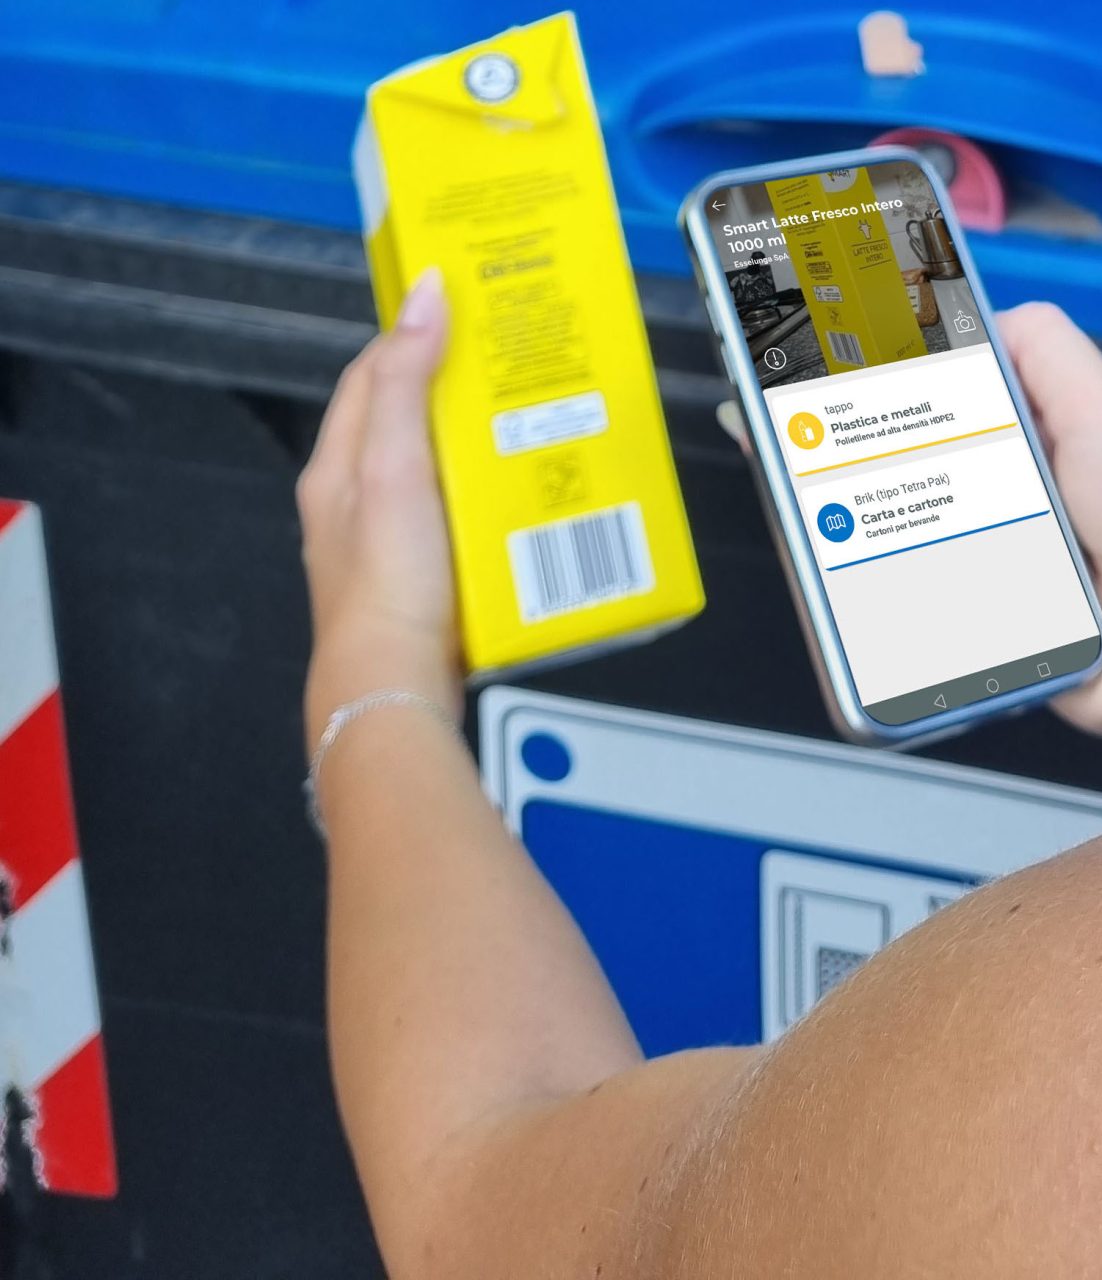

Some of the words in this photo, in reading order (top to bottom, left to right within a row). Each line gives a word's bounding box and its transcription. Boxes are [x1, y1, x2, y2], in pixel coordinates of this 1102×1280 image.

[723, 220, 769, 236] Smart
[772, 213, 808, 228] Latte
[812, 206, 858, 222] Fresco
[862, 199, 902, 213] Intero
[728, 237, 763, 253] 1000
[768, 233, 786, 246] ml
[853, 247, 868, 256] LATTE
[869, 243, 888, 252] FRESCO
[734, 256, 772, 268] Esselunga
[774, 254, 789, 262] SpA
[824, 401, 854, 416] tappo
[831, 414, 879, 434] Plastica
[881, 413, 889, 422] e
[891, 401, 932, 420] metalli
[835, 433, 875, 447] Polietilene
[876, 429, 886, 439] ad
[887, 426, 901, 435] alta
[902, 419, 929, 433] densità
[930, 413, 955, 426] HDPE2
[854, 491, 875, 506] Brik
[876, 485, 899, 502] (tipo
[900, 480, 926, 494] Tetra
[927, 473, 950, 488] Pak)
[861, 509, 895, 525] Carta
[898, 506, 905, 516] e
[907, 494, 954, 513] cartone
[866, 525, 894, 539] Cartoni
[895, 522, 908, 532] per
[909, 513, 940, 528] bevande
